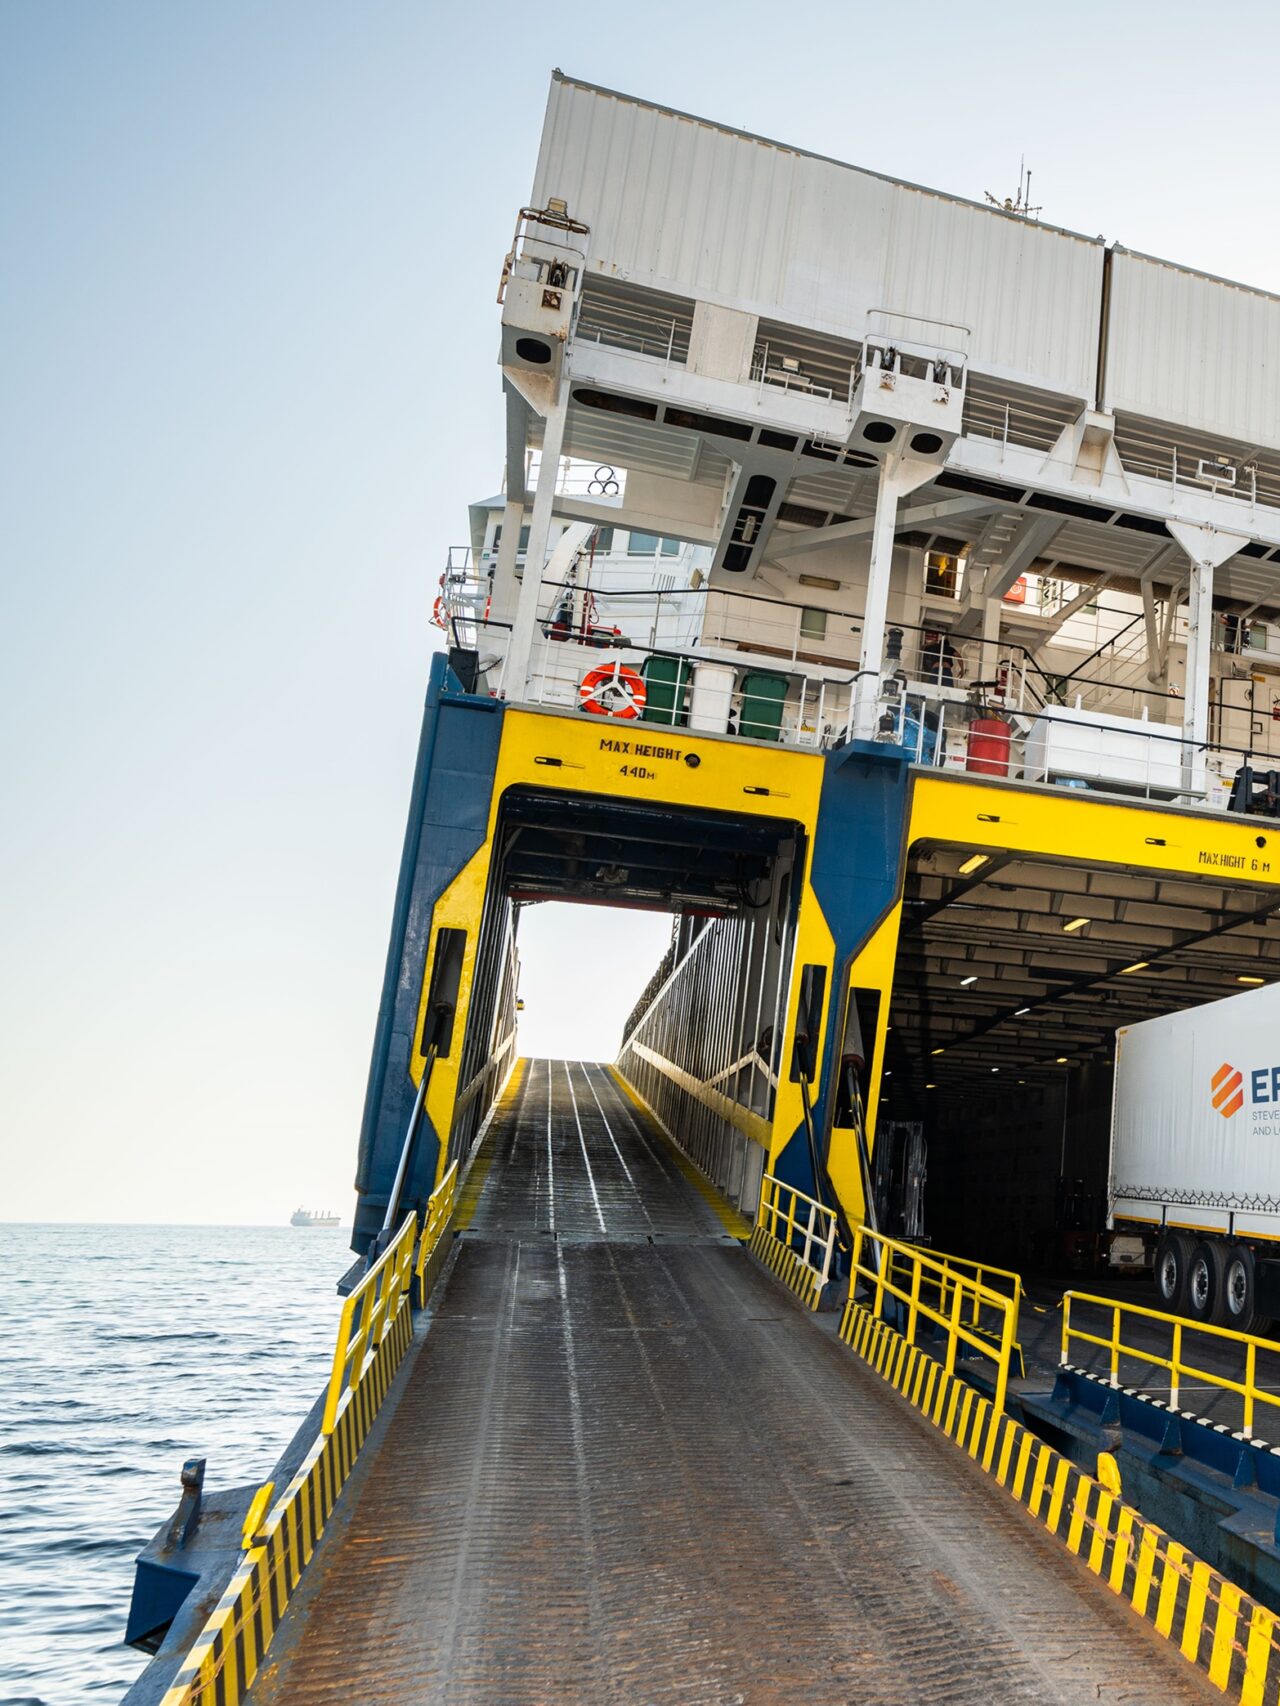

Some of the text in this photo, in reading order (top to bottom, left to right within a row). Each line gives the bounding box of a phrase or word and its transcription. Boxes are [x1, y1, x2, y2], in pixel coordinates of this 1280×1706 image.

[600, 739, 682, 761] MAX HEIGHT
[1252, 1125, 1271, 1136] AND
